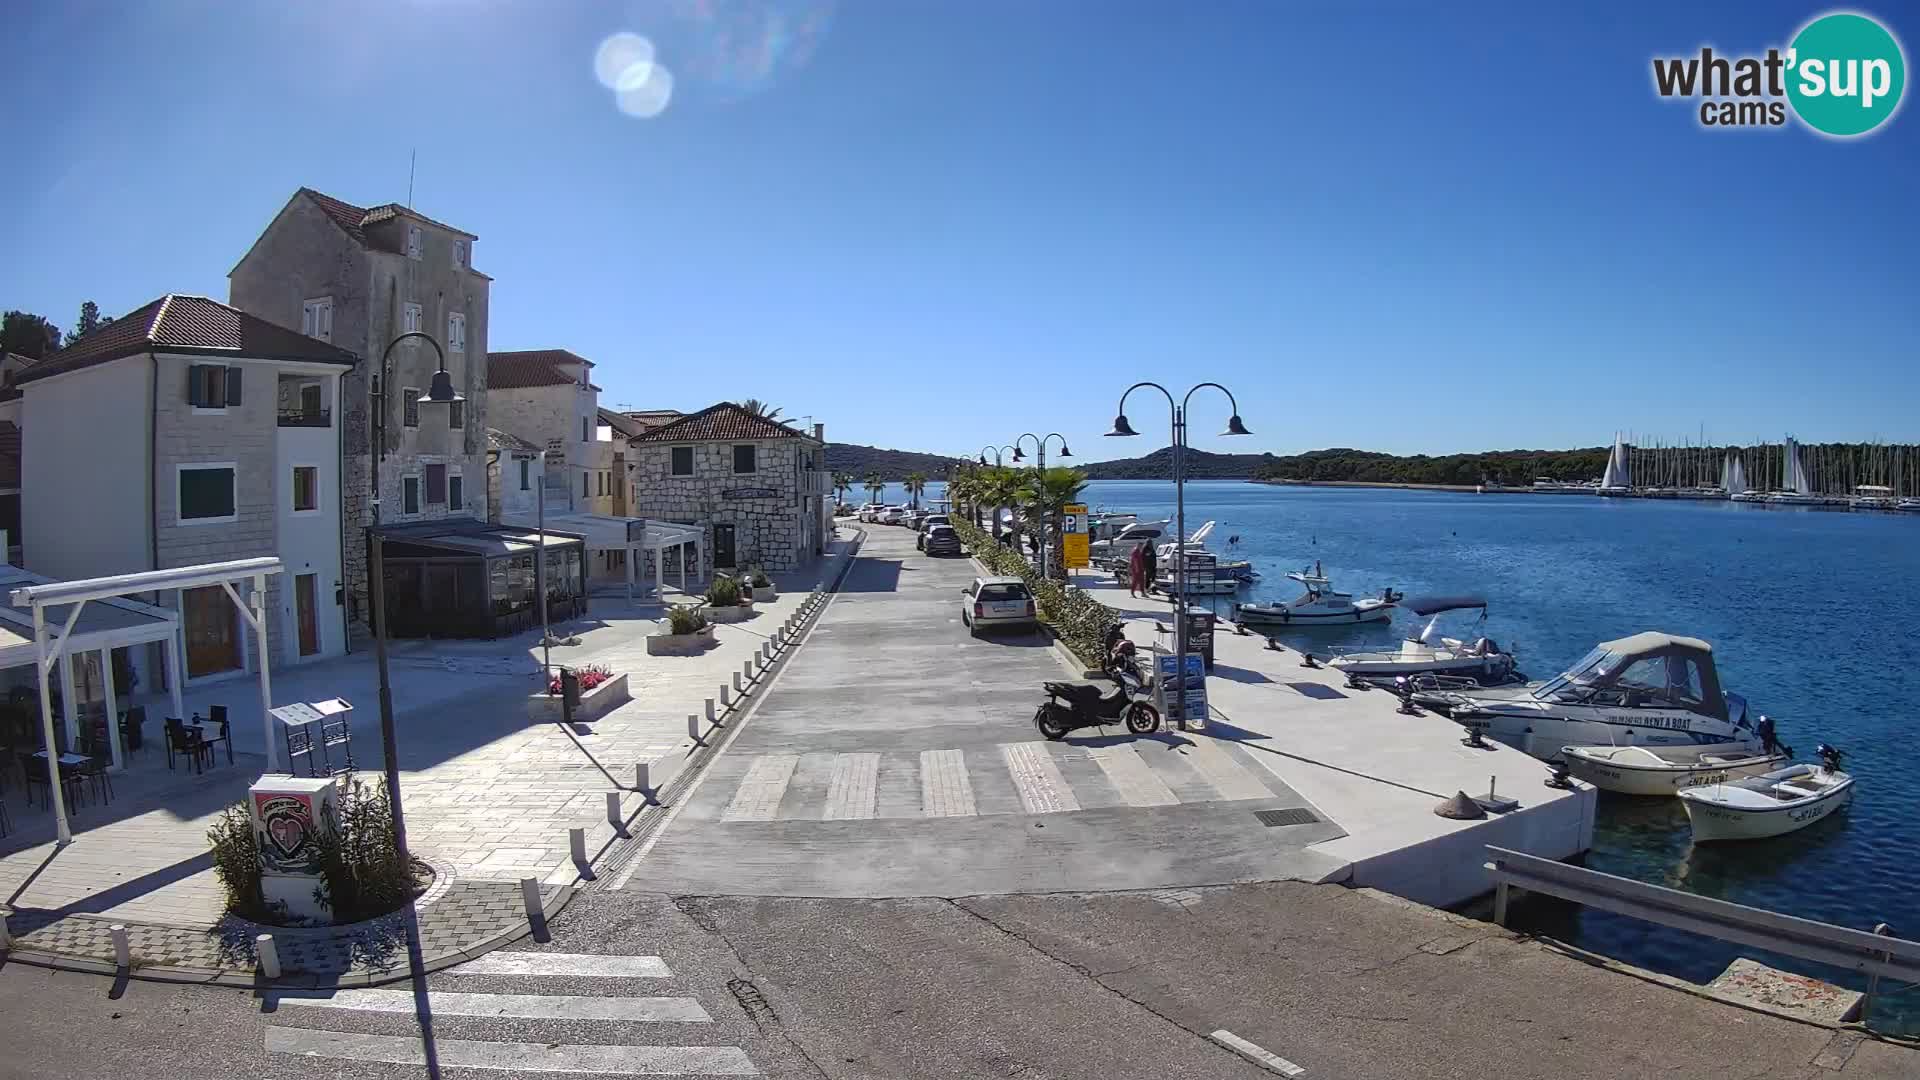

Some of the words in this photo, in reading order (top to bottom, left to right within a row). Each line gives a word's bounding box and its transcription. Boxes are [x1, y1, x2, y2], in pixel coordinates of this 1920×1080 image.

[1643, 716, 1664, 729] RENT
[1664, 717, 1671, 729] A
[1672, 718, 1692, 730] BOAT
